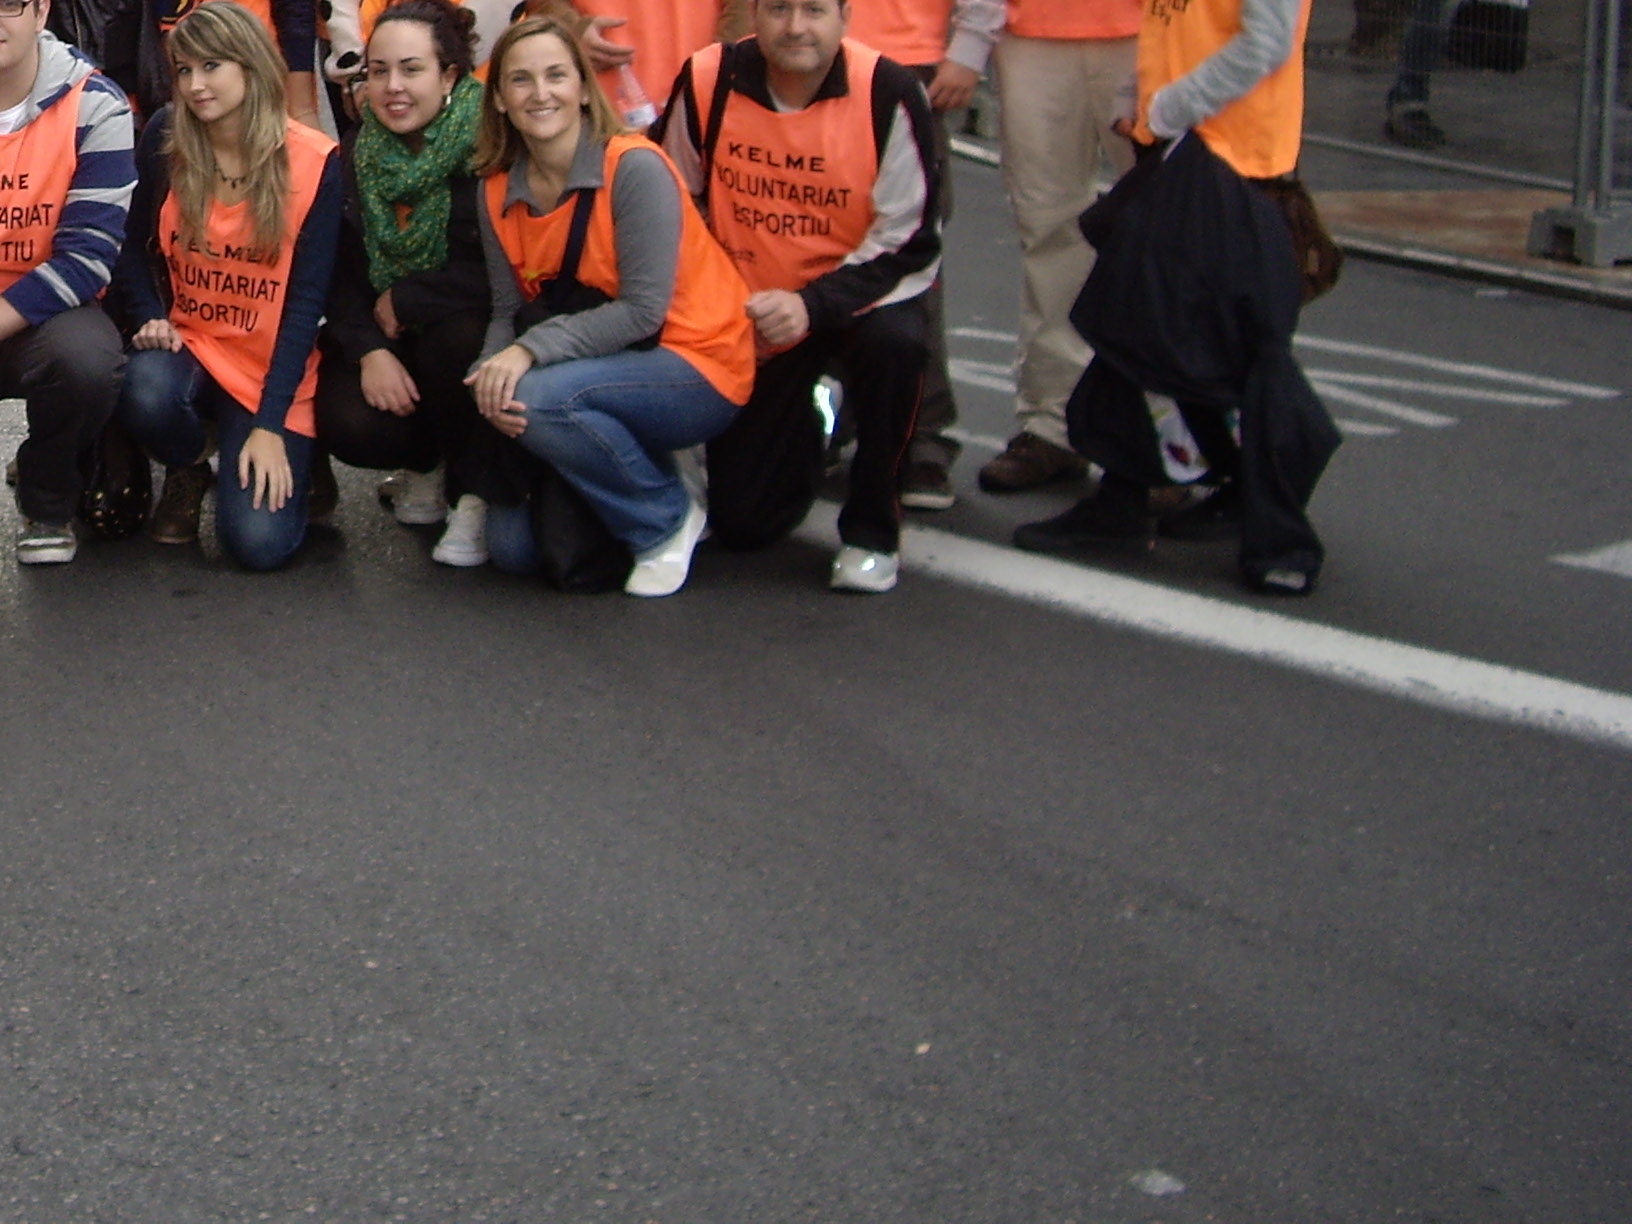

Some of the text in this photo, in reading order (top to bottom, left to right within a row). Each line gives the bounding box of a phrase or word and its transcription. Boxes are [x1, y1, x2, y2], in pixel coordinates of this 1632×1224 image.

[728, 141, 825, 173] KELME
[715, 162, 851, 209] VOLUNTARIAT
[732, 201, 832, 237] ESPORTIU
[171, 260, 280, 303] UNTARIAT
[176, 293, 259, 332] SPORTIU
